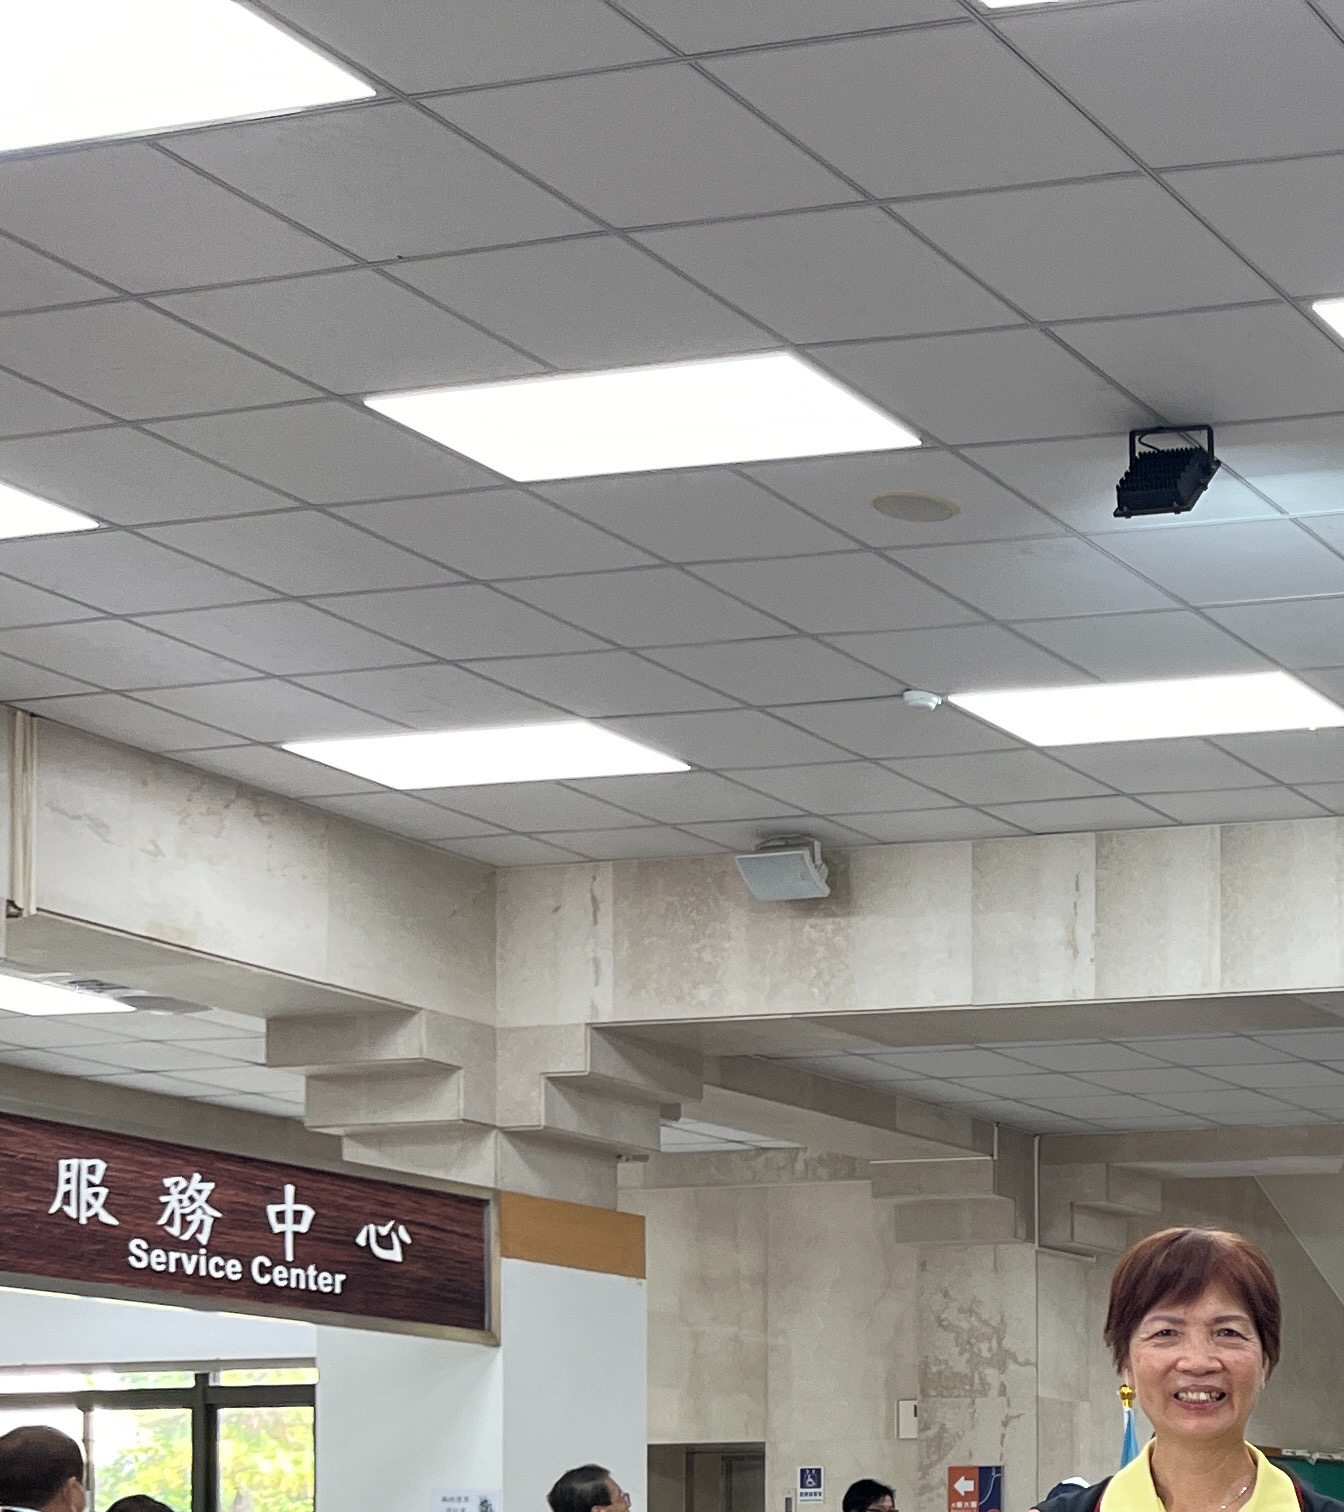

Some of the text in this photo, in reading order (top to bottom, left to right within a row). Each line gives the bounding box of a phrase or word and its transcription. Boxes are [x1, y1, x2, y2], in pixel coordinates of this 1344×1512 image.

[48, 1157, 412, 1262] 服務中心
[128, 1238, 347, 1295] Service Center
